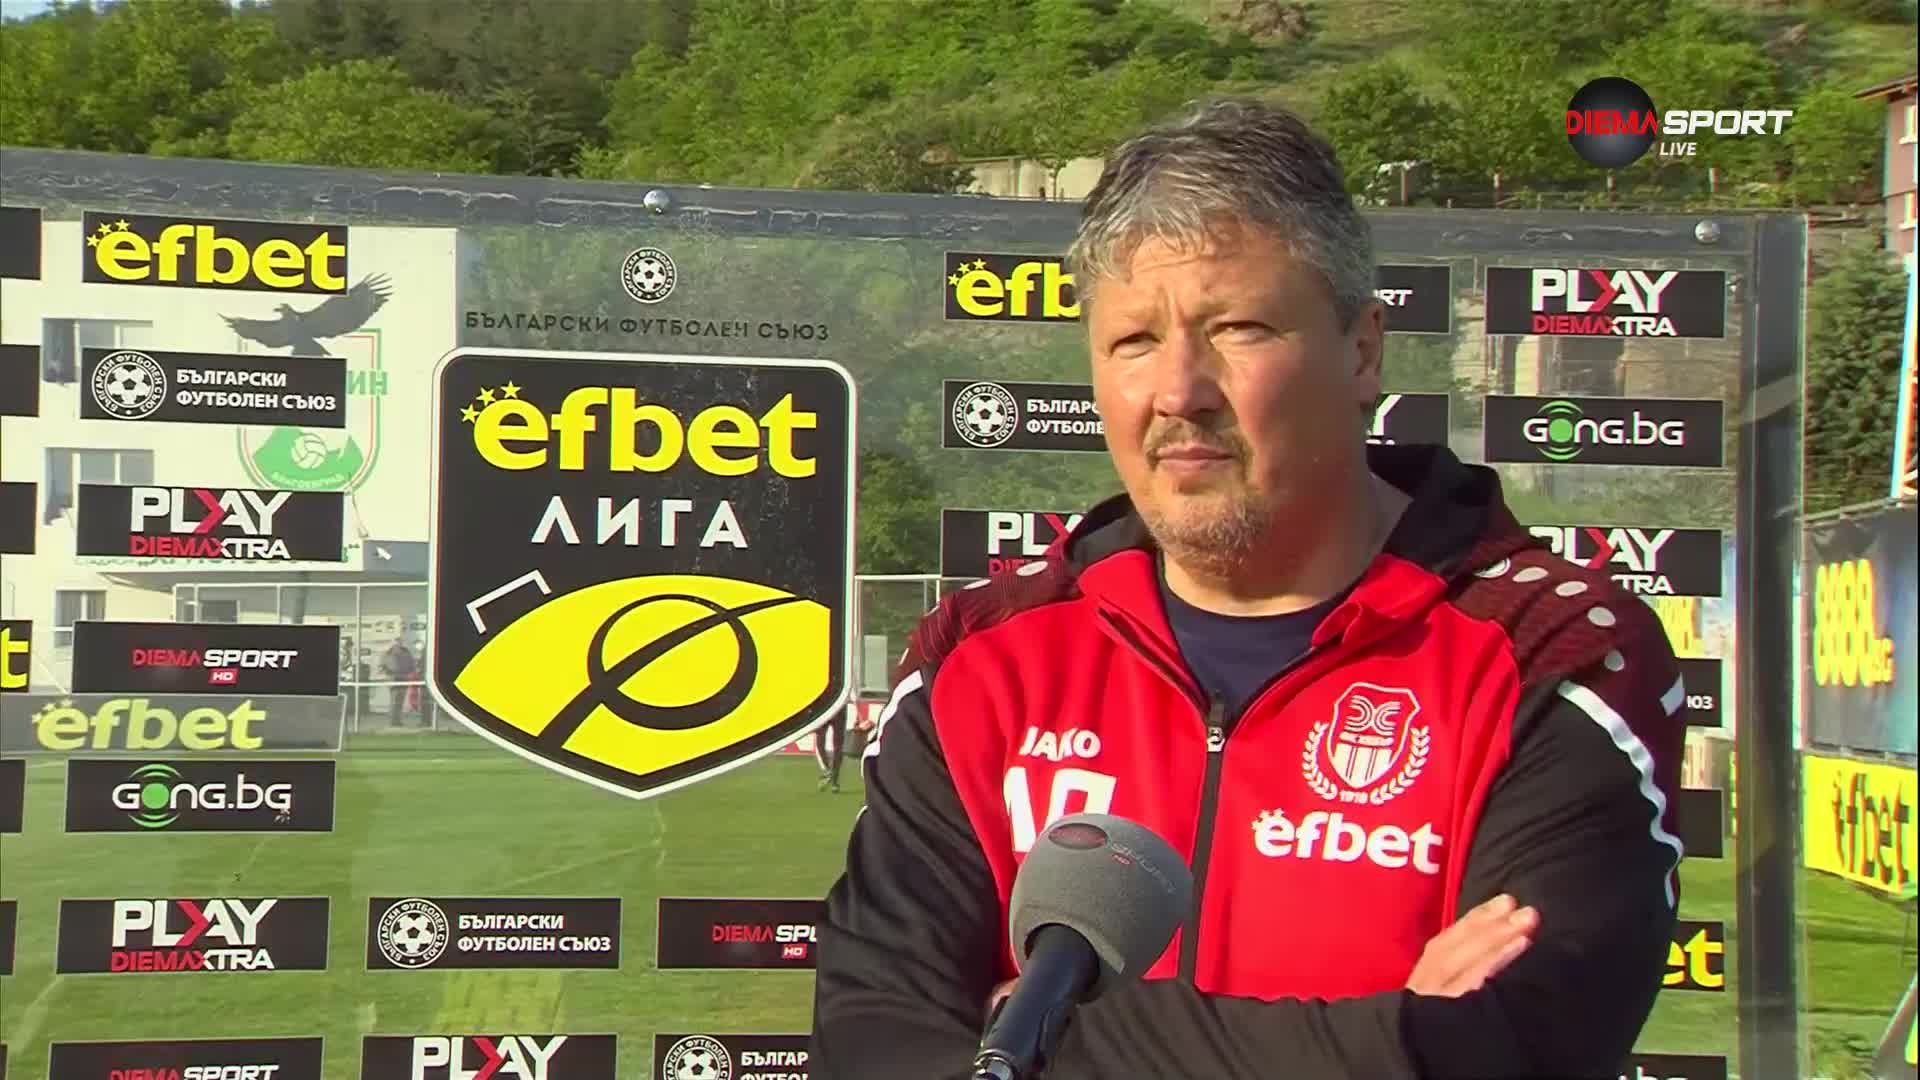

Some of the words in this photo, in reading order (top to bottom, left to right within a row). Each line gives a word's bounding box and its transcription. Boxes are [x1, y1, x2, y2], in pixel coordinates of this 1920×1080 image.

[95, 223, 346, 291] efbet
[956, 262, 1080, 318] efb
[1531, 269, 1679, 313] PLAY
[465, 312, 609, 334] БЪЛГАРСКИ
[619, 317, 748, 338] ФУТБОЛЕН
[757, 322, 830, 342] СЪЮЗ
[176, 368, 287, 387] БЪЛГАРСКИ
[176, 390, 279, 408] ФУТБОЛЕН
[282, 394, 337, 411] СЪЮЗ
[1026, 399, 1100, 414] БЪЛГАР
[473, 386, 817, 478] efbet
[1026, 419, 1105, 434] ФУТБОЛЕ
[130, 487, 293, 535] PLAY
[530, 495, 749, 548] ЛИГА
[988, 512, 1083, 555] PL
[132, 650, 199, 667] DIEMA
[203, 650, 298, 668] SPORT
[212, 672, 233, 681] HD
[35, 699, 266, 750] efbet
[1019, 726, 1101, 762] JAKO
[1253, 810, 1444, 875] efbet
[112, 899, 278, 947] PLAY
[458, 914, 564, 929] БЪЛГАРСКИ
[712, 925, 773, 942] DIEMA
[457, 936, 556, 952] ФУТБОЛЕН
[558, 936, 611, 951] СЪЮЗ
[784, 947, 803, 956] HD
[184, 1065, 279, 1080] SPORT
[412, 1036, 568, 1080] PLAY
[740, 1052, 809, 1066] БЪЛГАР
